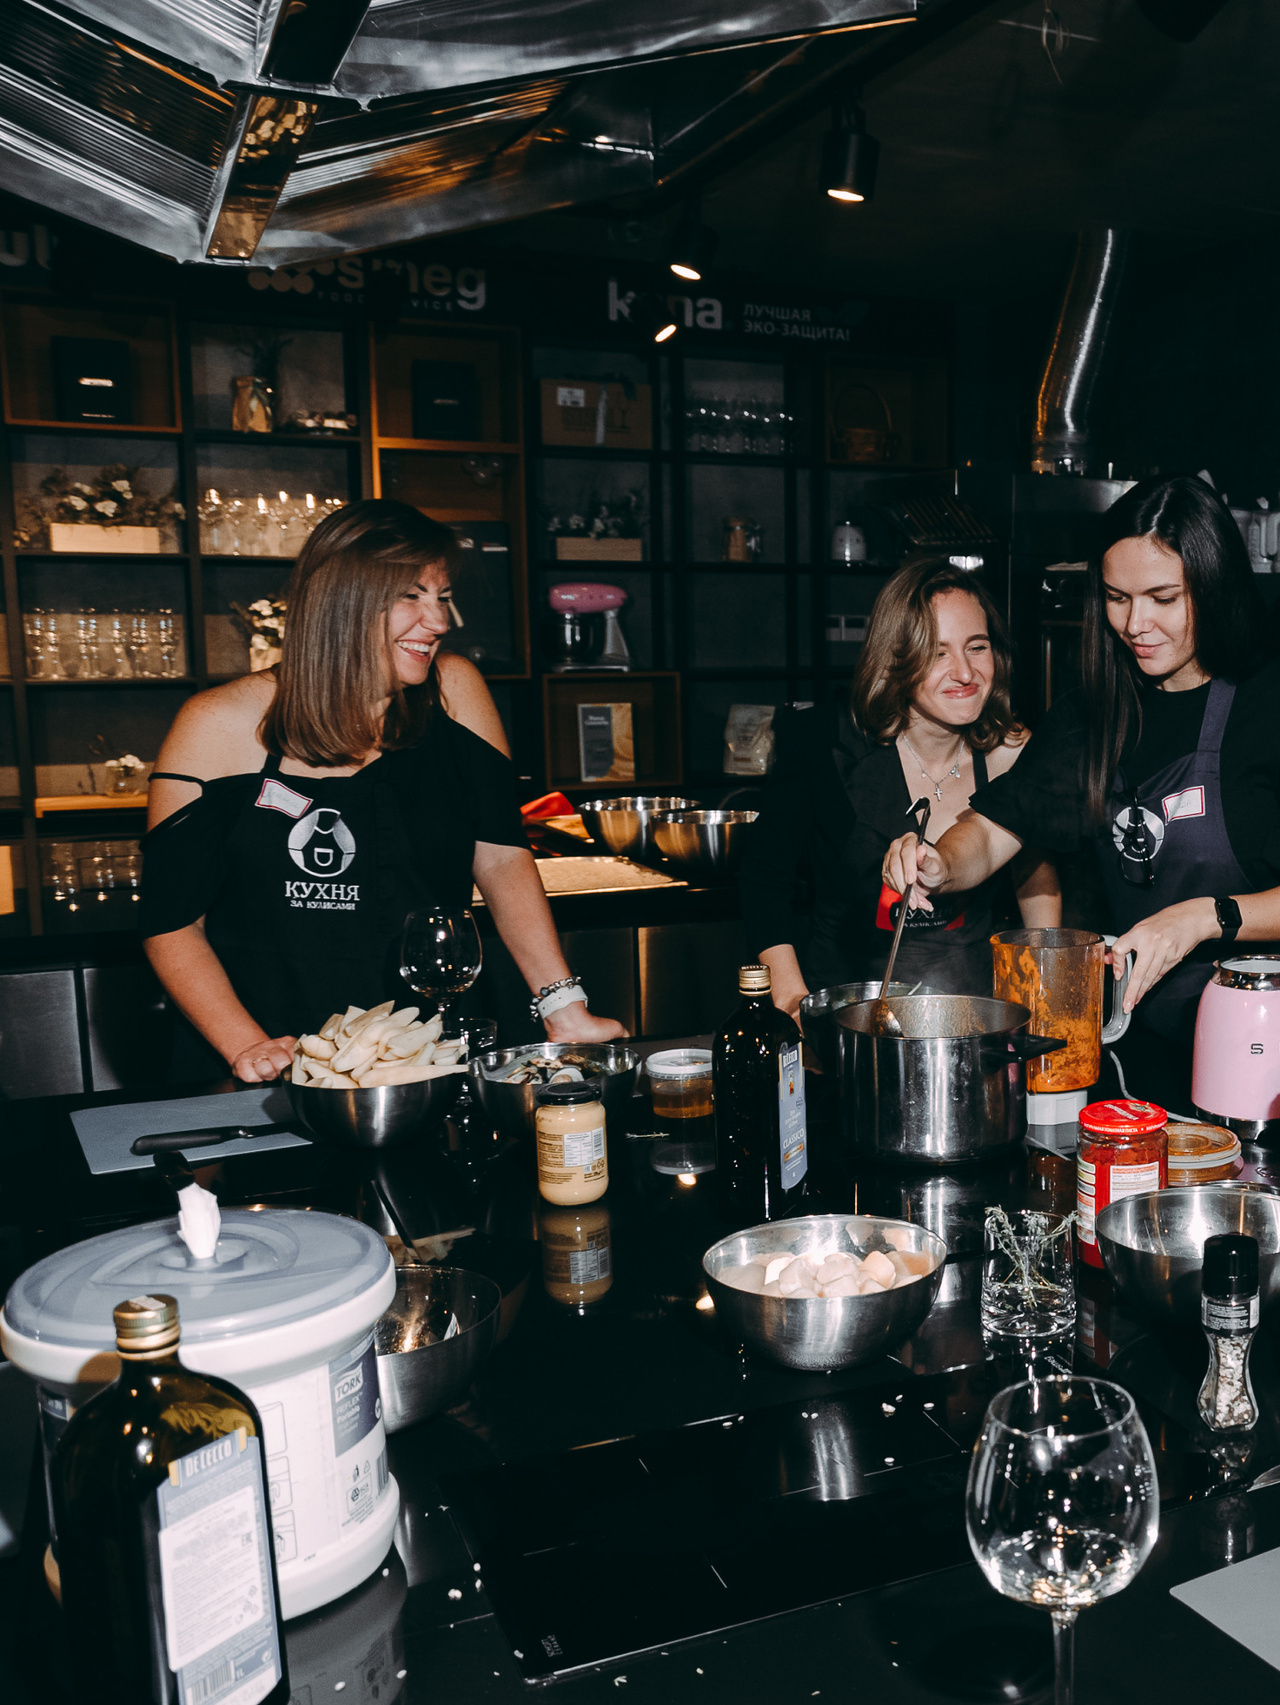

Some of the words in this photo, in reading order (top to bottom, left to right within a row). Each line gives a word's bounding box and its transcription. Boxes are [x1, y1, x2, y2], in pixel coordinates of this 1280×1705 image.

[608, 277, 723, 330] kna
[744, 303, 811, 321] ЛУЧШАЯ
[744, 320, 850, 342] ЭКО-ЗАЩИТА!
[285, 880, 360, 901] КУХНЯ
[290, 900, 304, 908] ЗА
[306, 901, 356, 911] КУЛИСАМИ
[336, 1374, 361, 1399] TORK
